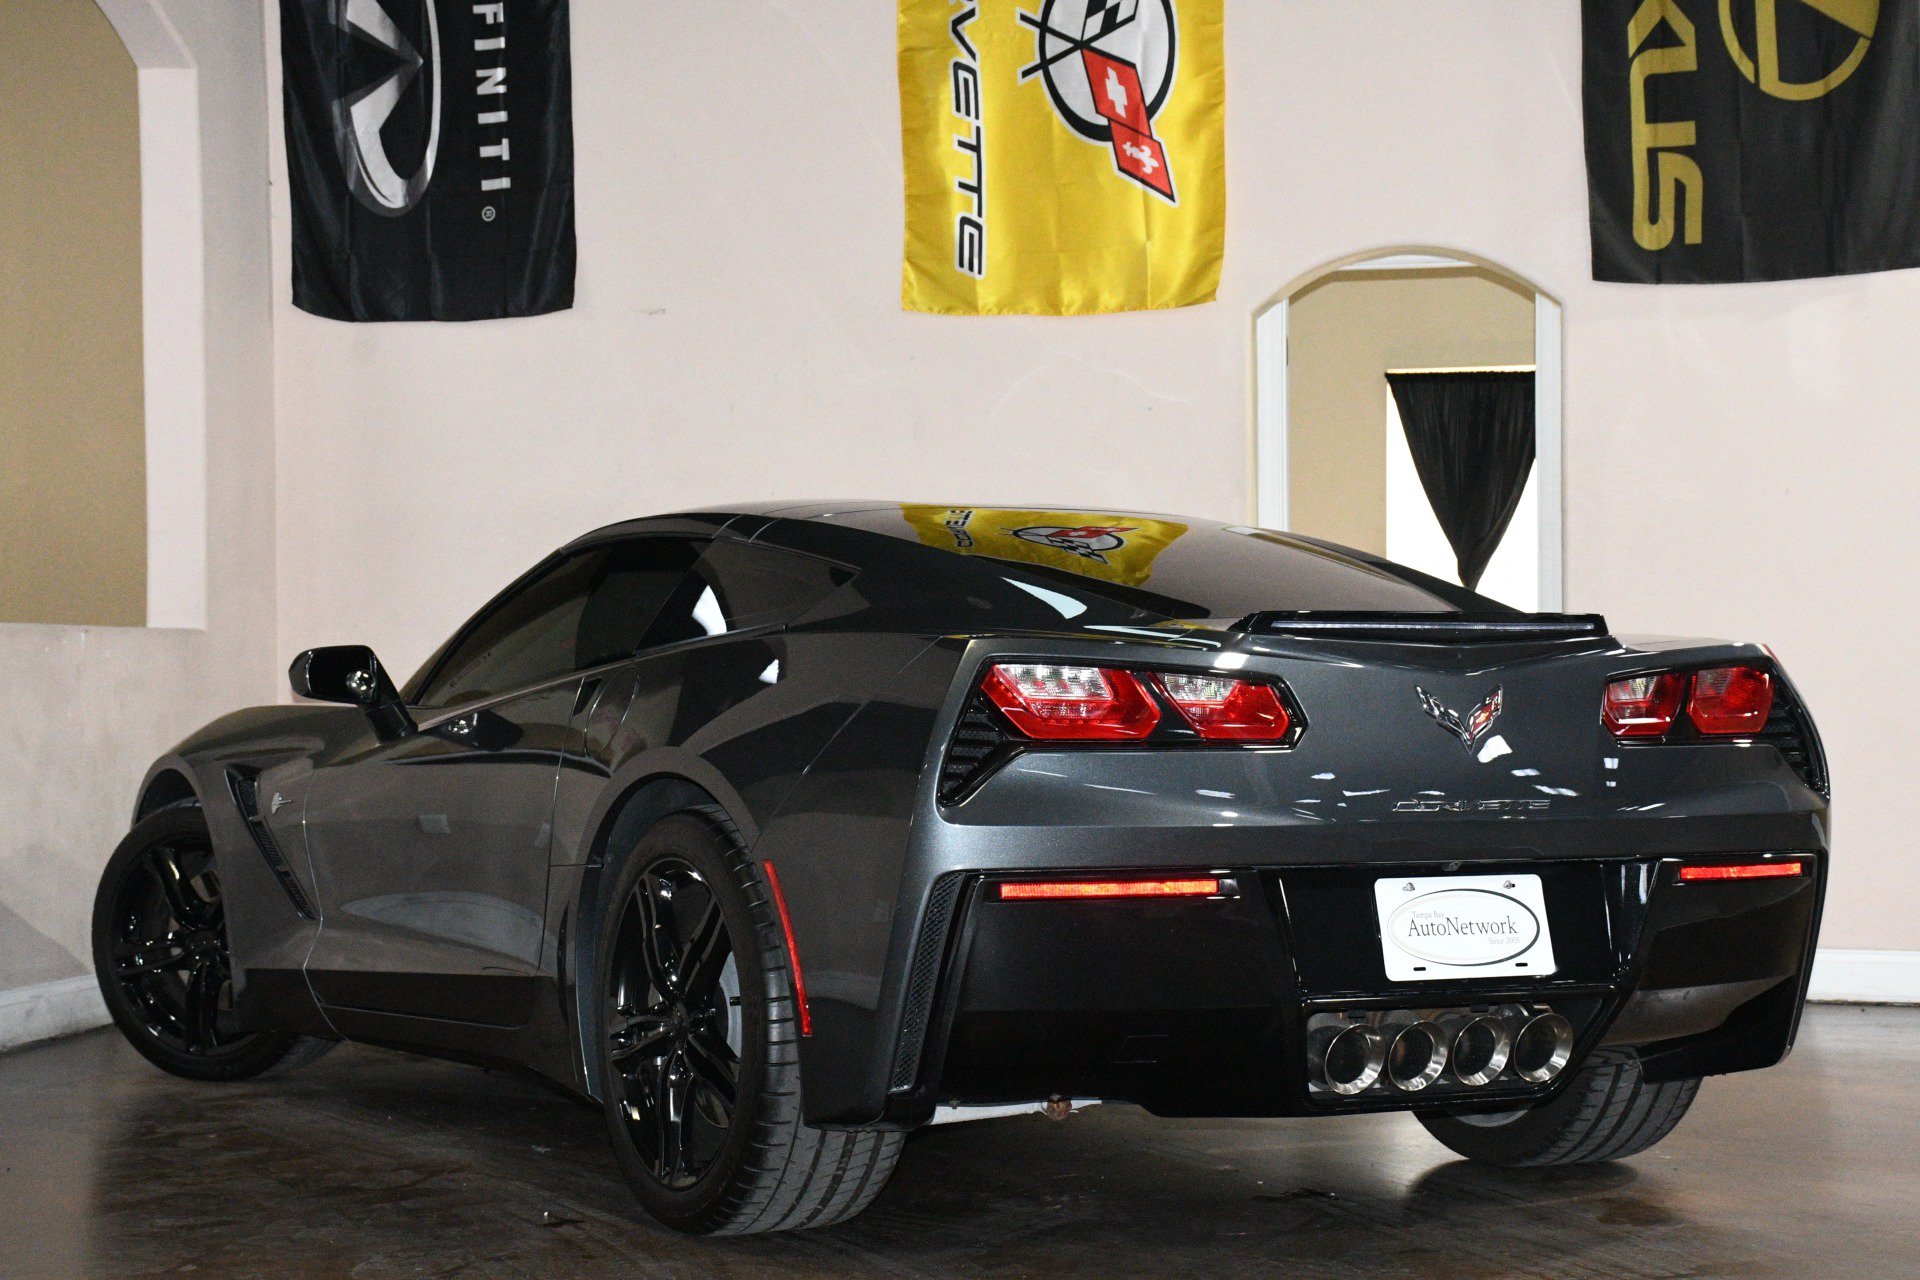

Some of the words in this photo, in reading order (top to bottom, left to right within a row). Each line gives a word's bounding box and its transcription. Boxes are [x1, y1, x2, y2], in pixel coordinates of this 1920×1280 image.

[472, 2, 512, 192] FINITI
[949, 0, 985, 277] VETTE
[1408, 915, 1518, 937] AutoNetwork
[1412, 911, 1432, 920] Tampa
[1433, 910, 1445, 919] Bay
[1488, 936, 1505, 945] Since
